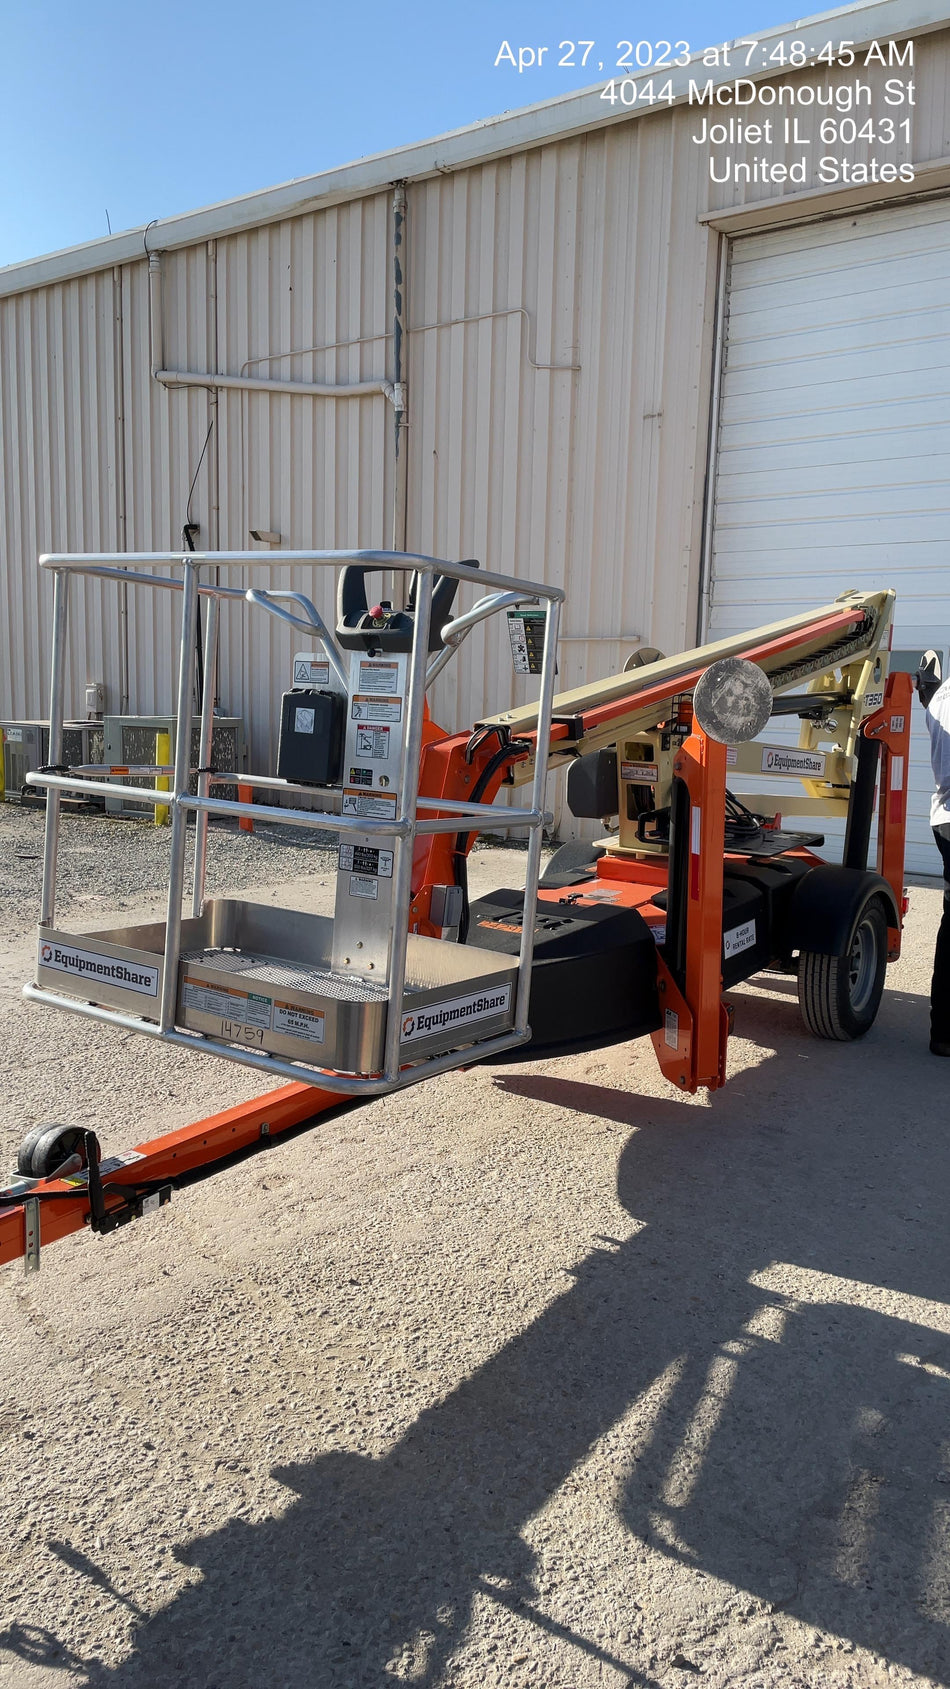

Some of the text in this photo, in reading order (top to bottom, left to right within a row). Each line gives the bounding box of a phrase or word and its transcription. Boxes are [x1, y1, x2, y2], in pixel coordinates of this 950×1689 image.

[774, 754, 822, 771] EquipmentShare
[54, 949, 152, 987] EquipmentShare
[252, 994, 268, 1003] NOTICE
[287, 1010, 298, 1018] NOT
[298, 1013, 320, 1024] EXCEED
[416, 995, 506, 1031] EquipmentShare
[221, 1020, 264, 1045] 14759
